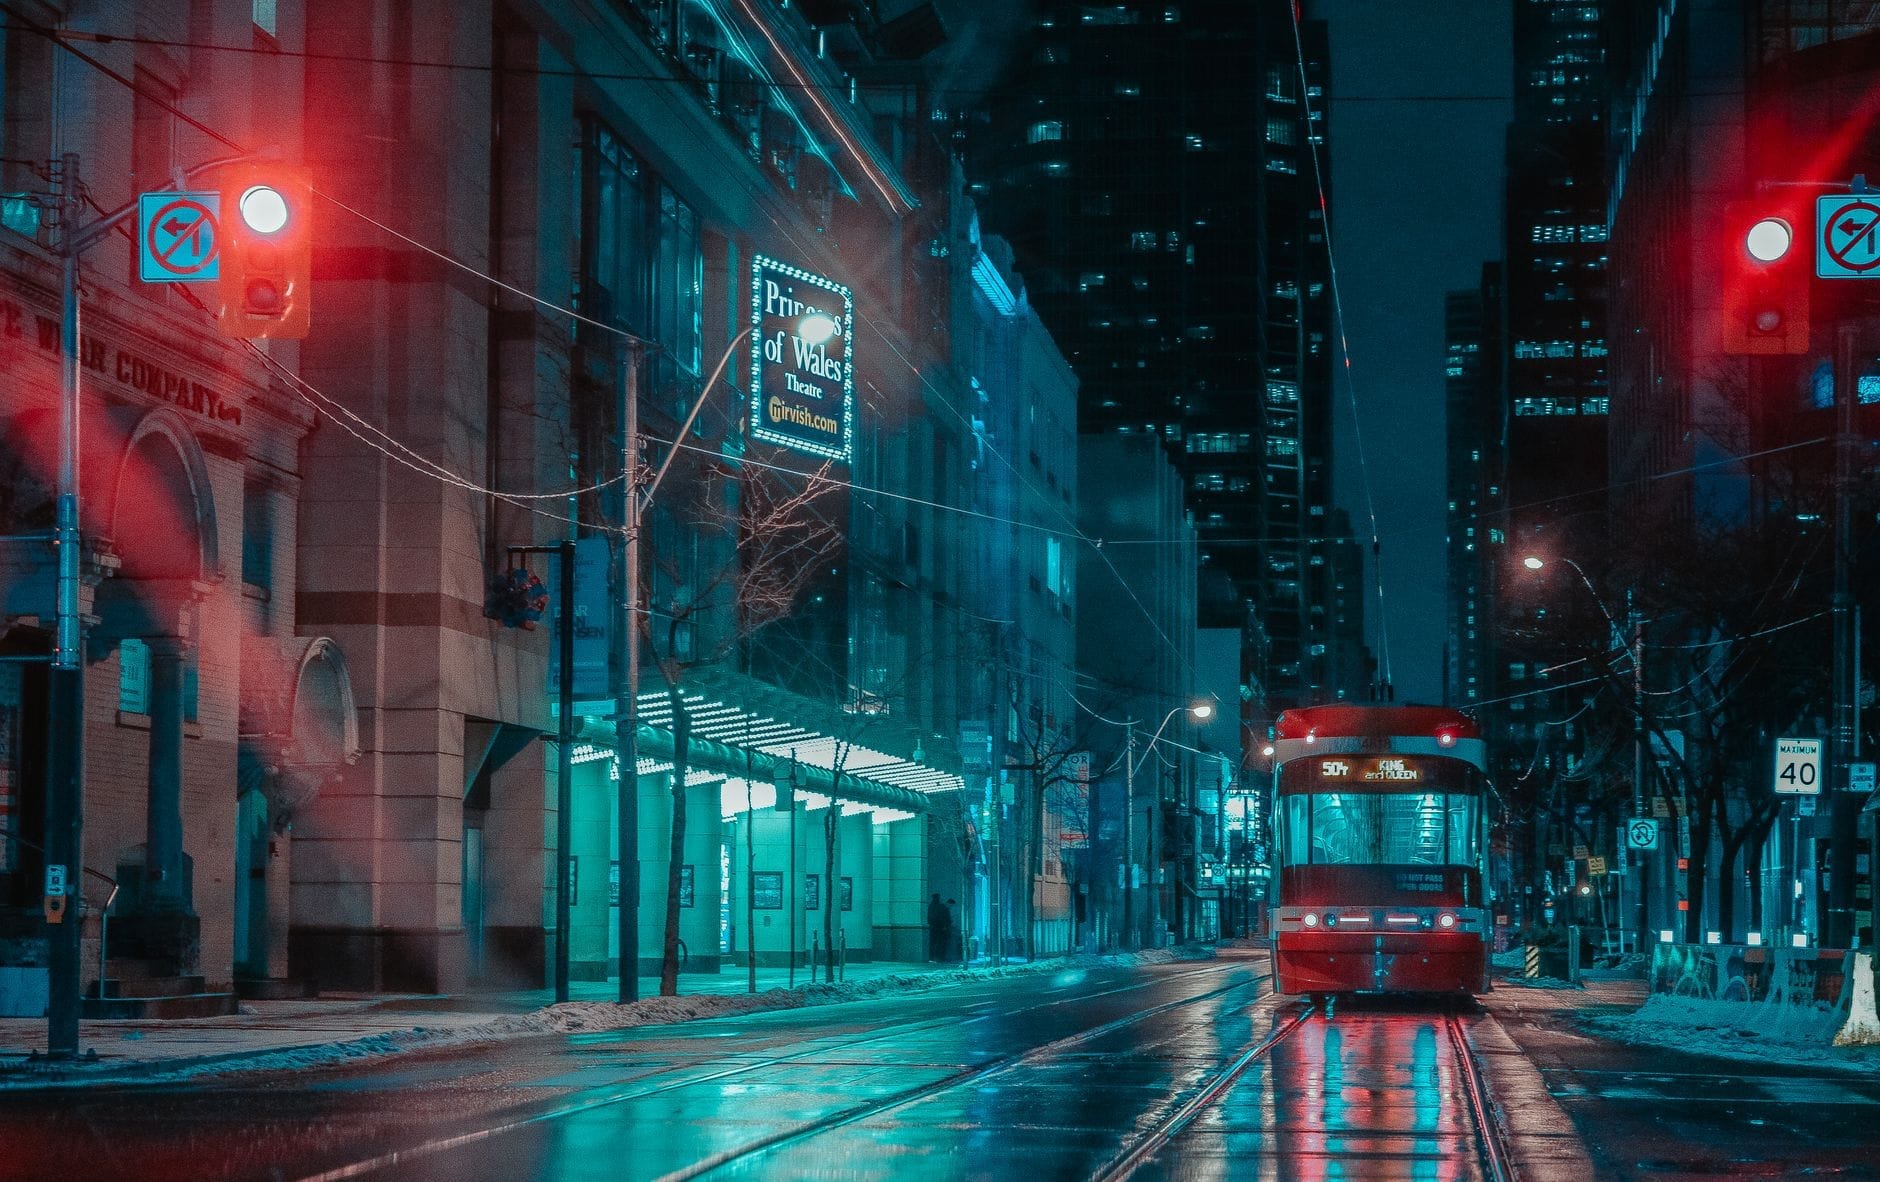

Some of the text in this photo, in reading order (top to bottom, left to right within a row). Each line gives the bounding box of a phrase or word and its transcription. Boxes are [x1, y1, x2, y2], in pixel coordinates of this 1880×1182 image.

[765, 280, 842, 337] Prins
[765, 331, 842, 383] of Wales
[116, 351, 219, 419] COMPANY
[785, 373, 823, 399] Theatre
[769, 396, 838, 434] mirvish.com
[1780, 746, 1817, 754] MAXIMUM
[1322, 761, 1349, 776] 504
[1365, 770, 1417, 780] and QUEEN
[1379, 760, 1404, 770] KING
[1780, 763, 1815, 785] 40
